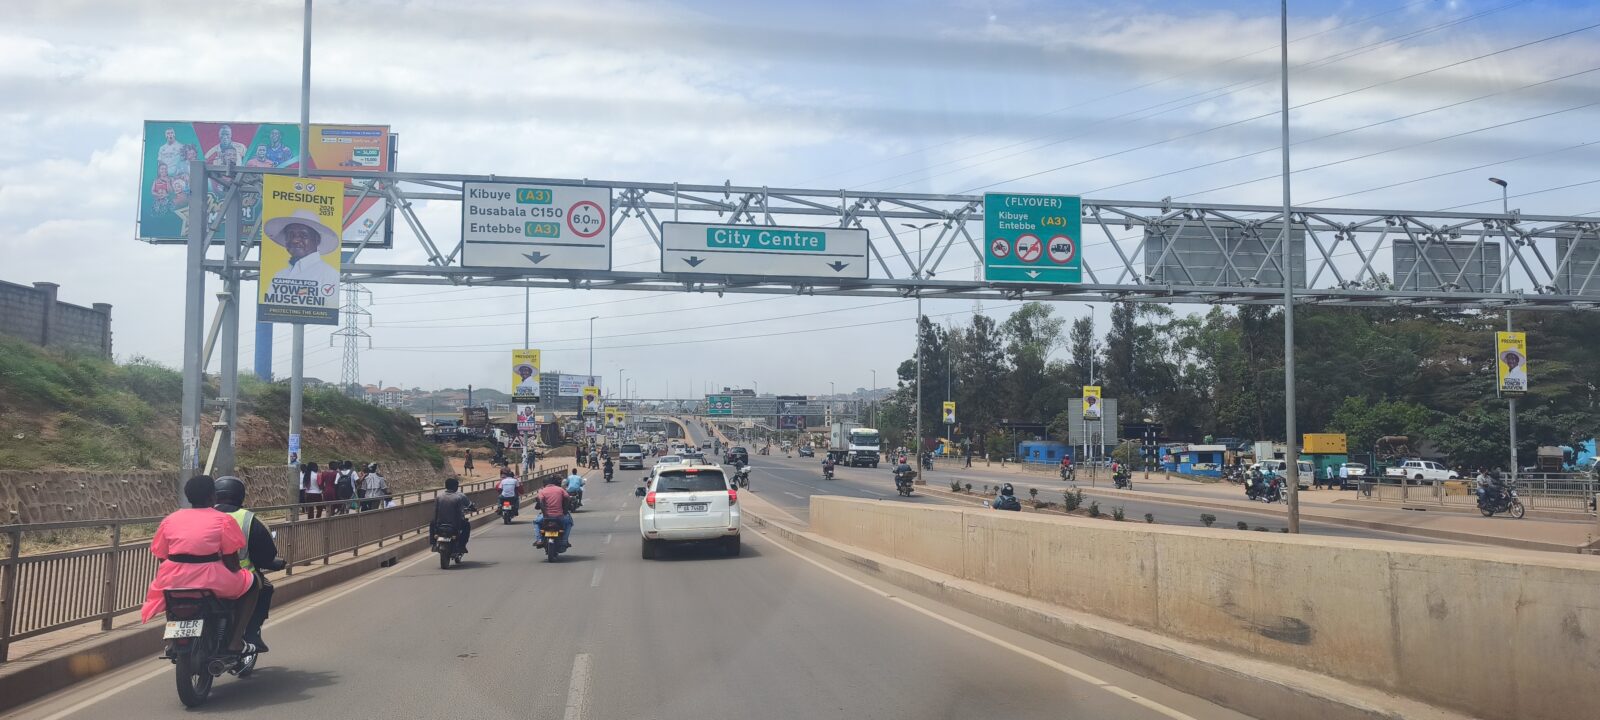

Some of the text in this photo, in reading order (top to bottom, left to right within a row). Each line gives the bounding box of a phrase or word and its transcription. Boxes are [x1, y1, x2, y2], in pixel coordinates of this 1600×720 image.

[272, 190, 335, 206] PRESIDENT
[470, 188, 551, 201] Kibuye (A3)
[1005, 196, 1062, 209] (FLYOVER)
[469, 205, 563, 218] Busabala C150
[998, 211, 1029, 221] Kibuye
[999, 221, 1036, 230] Entebbe
[1041, 215, 1067, 227] (A3)
[470, 223, 559, 236] Entebbe (A3)
[714, 229, 819, 248] City Centre
[272, 284, 319, 297] YOWERI
[264, 292, 325, 306] MUSEVENI
